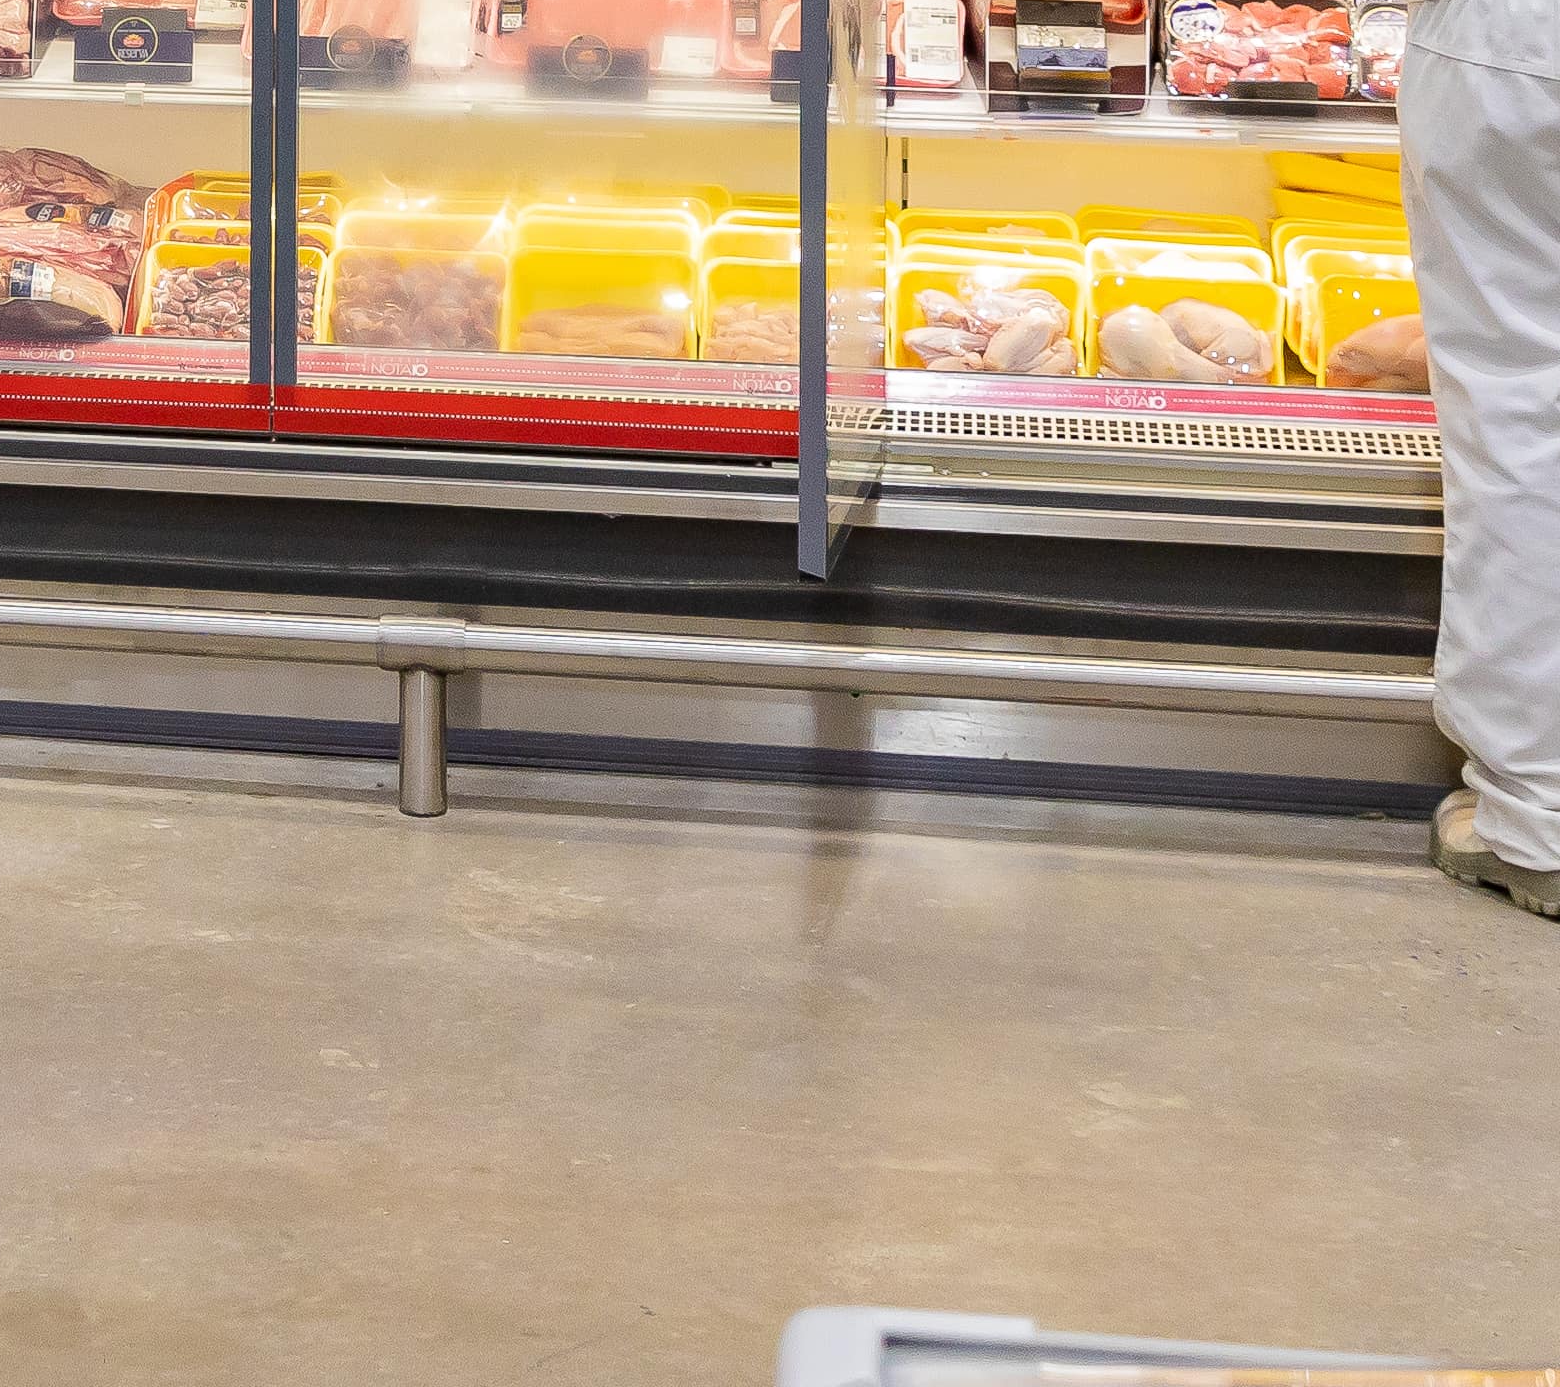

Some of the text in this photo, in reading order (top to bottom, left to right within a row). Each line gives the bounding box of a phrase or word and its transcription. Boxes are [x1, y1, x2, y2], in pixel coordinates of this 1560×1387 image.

[370, 364, 428, 376] NOTA10
[733, 380, 793, 393] NOTA10
[1105, 395, 1166, 409] NOTA10
